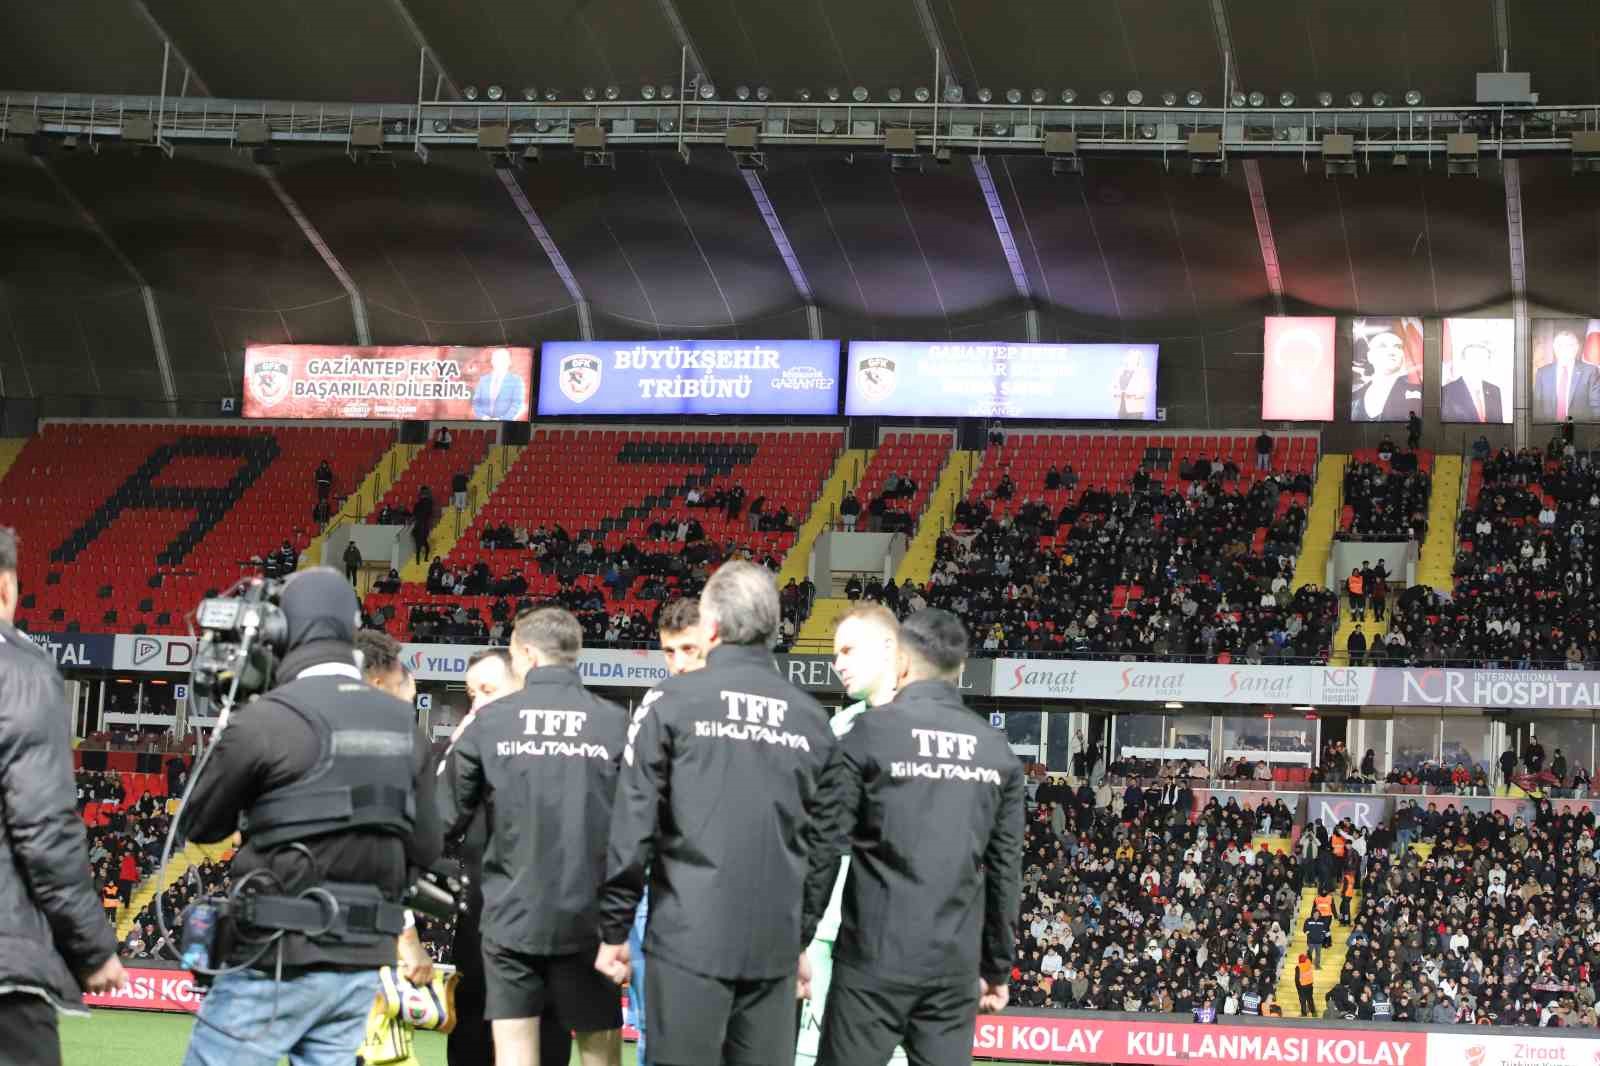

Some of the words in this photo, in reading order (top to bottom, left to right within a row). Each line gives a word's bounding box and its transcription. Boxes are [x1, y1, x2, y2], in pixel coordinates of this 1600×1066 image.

[308, 357, 405, 375] GAZİANTEP
[614, 346, 780, 373] BÜYÜKŞEHİR
[295, 382, 390, 399] BAŞARILAR
[638, 374, 752, 398] TRİBÜNÜ
[427, 658, 469, 673] YILD
[1009, 664, 1079, 690] Sanat
[1474, 672, 1558, 682] INTERNATIONAL
[177, 687, 185, 697] B
[1116, 667, 1184, 694] Sanat
[1223, 671, 1293, 697] Sanat
[1402, 667, 1469, 703] NCR
[1473, 681, 1600, 706] HOSPITAL
[419, 696, 428, 708] C
[720, 690, 788, 727] TFF
[519, 709, 587, 737] TFF
[911, 728, 977, 760] TFF
[1012, 1025, 1104, 1053] KOLAY
[1127, 1031, 1309, 1062] KULLANMASI
[1316, 1039, 1411, 1066] KOLAY
[1512, 1043, 1567, 1060] Ziraat
